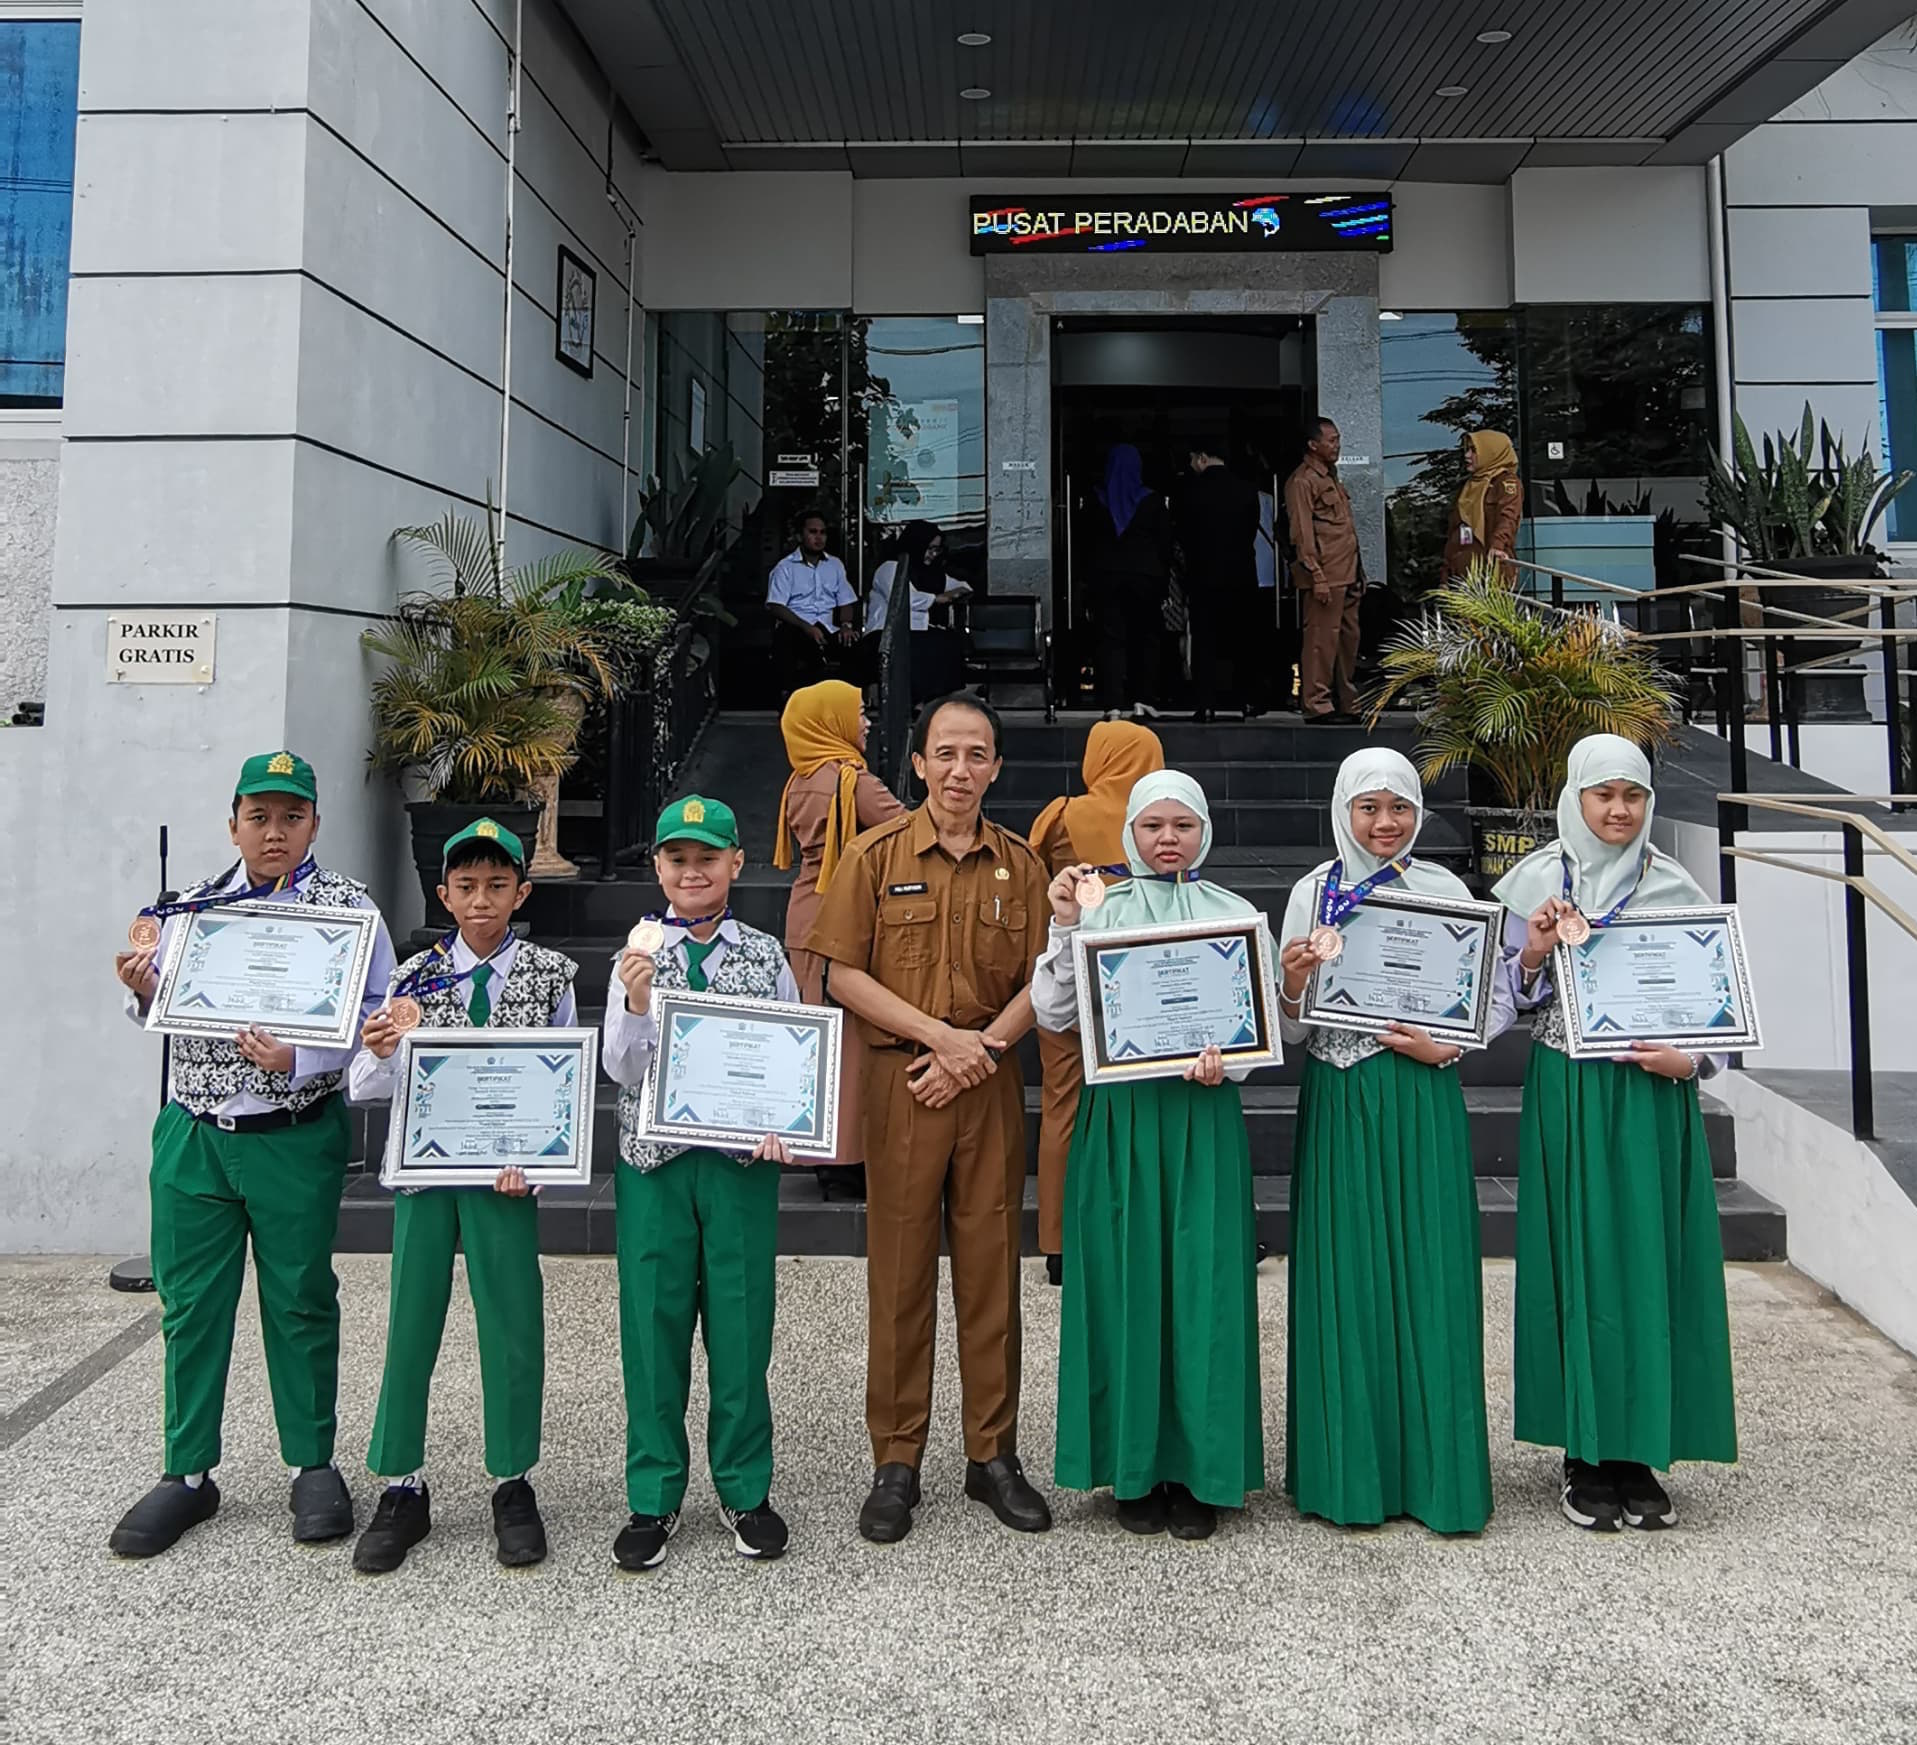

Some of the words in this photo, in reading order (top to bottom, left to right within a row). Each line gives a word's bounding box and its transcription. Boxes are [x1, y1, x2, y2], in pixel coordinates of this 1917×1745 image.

[973, 212, 1064, 235] PUSAT
[1075, 211, 1249, 234] PERADABAN
[121, 624, 199, 638] PARKIR
[119, 648, 195, 663] GRATIS
[1486, 833, 1536, 853] SMP
